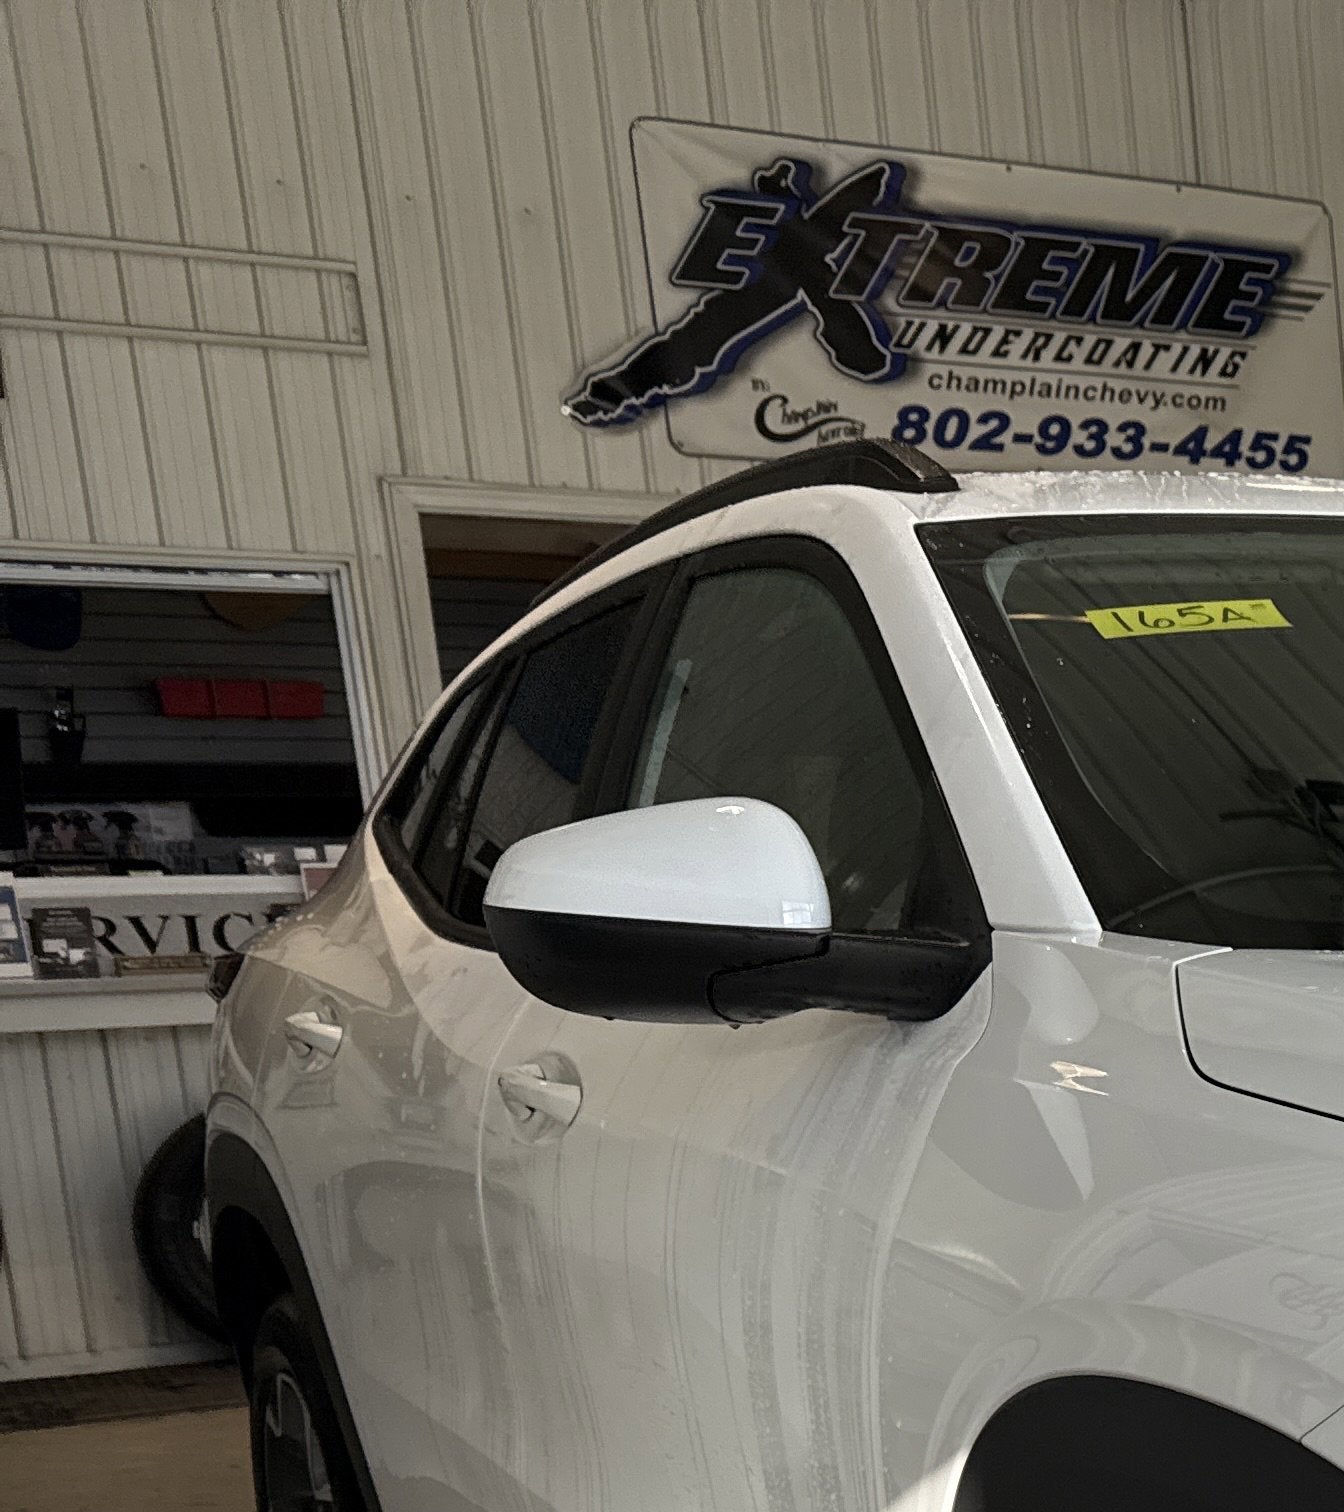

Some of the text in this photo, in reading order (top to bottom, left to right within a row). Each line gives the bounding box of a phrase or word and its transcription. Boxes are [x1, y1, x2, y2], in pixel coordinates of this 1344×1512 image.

[890, 319, 1247, 380] UNDERCOATING
[927, 369, 1228, 413] champlainchevy.com
[890, 404, 1313, 473] 802-933-4455
[1110, 605, 1257, 632] 165A
